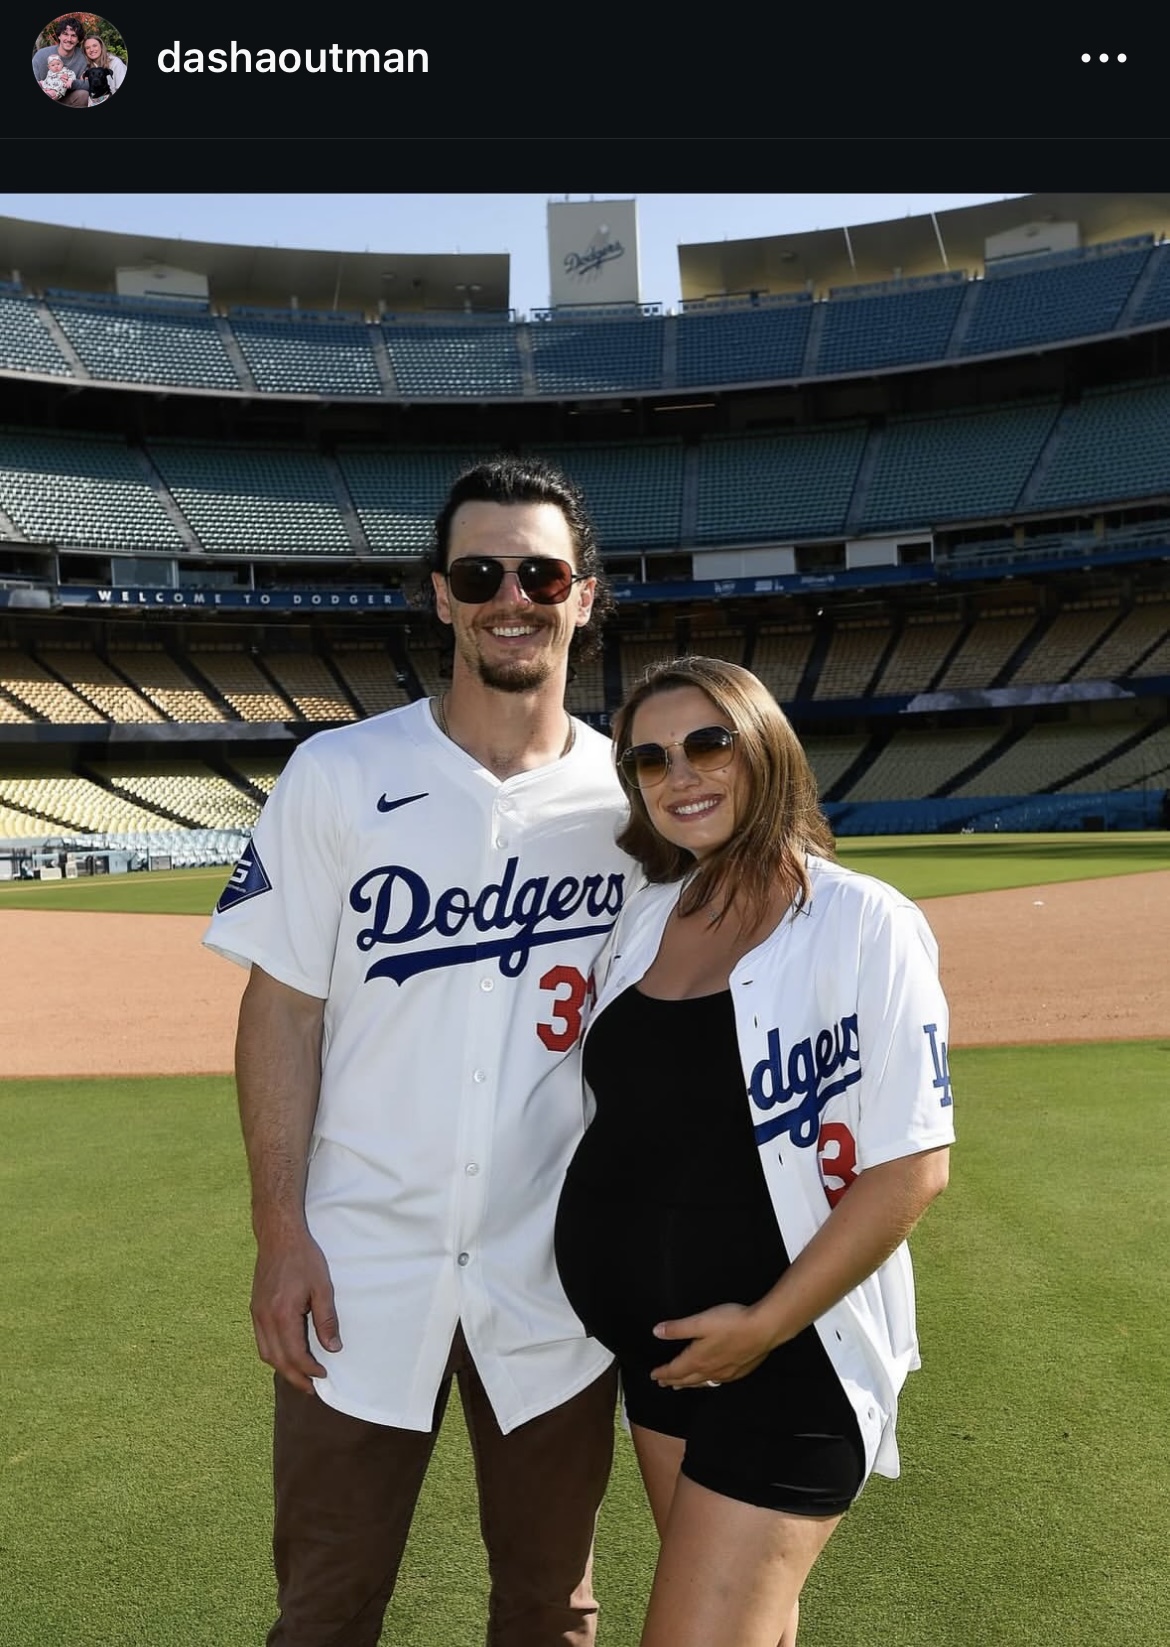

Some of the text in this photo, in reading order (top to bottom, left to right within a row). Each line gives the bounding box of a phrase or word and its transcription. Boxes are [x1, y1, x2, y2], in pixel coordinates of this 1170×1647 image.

[563, 240, 625, 275] Dodgers
[98, 590, 392, 604] WELCOME TO DODGER
[349, 857, 626, 978] Dodgers
[536, 965, 597, 1052] 3
